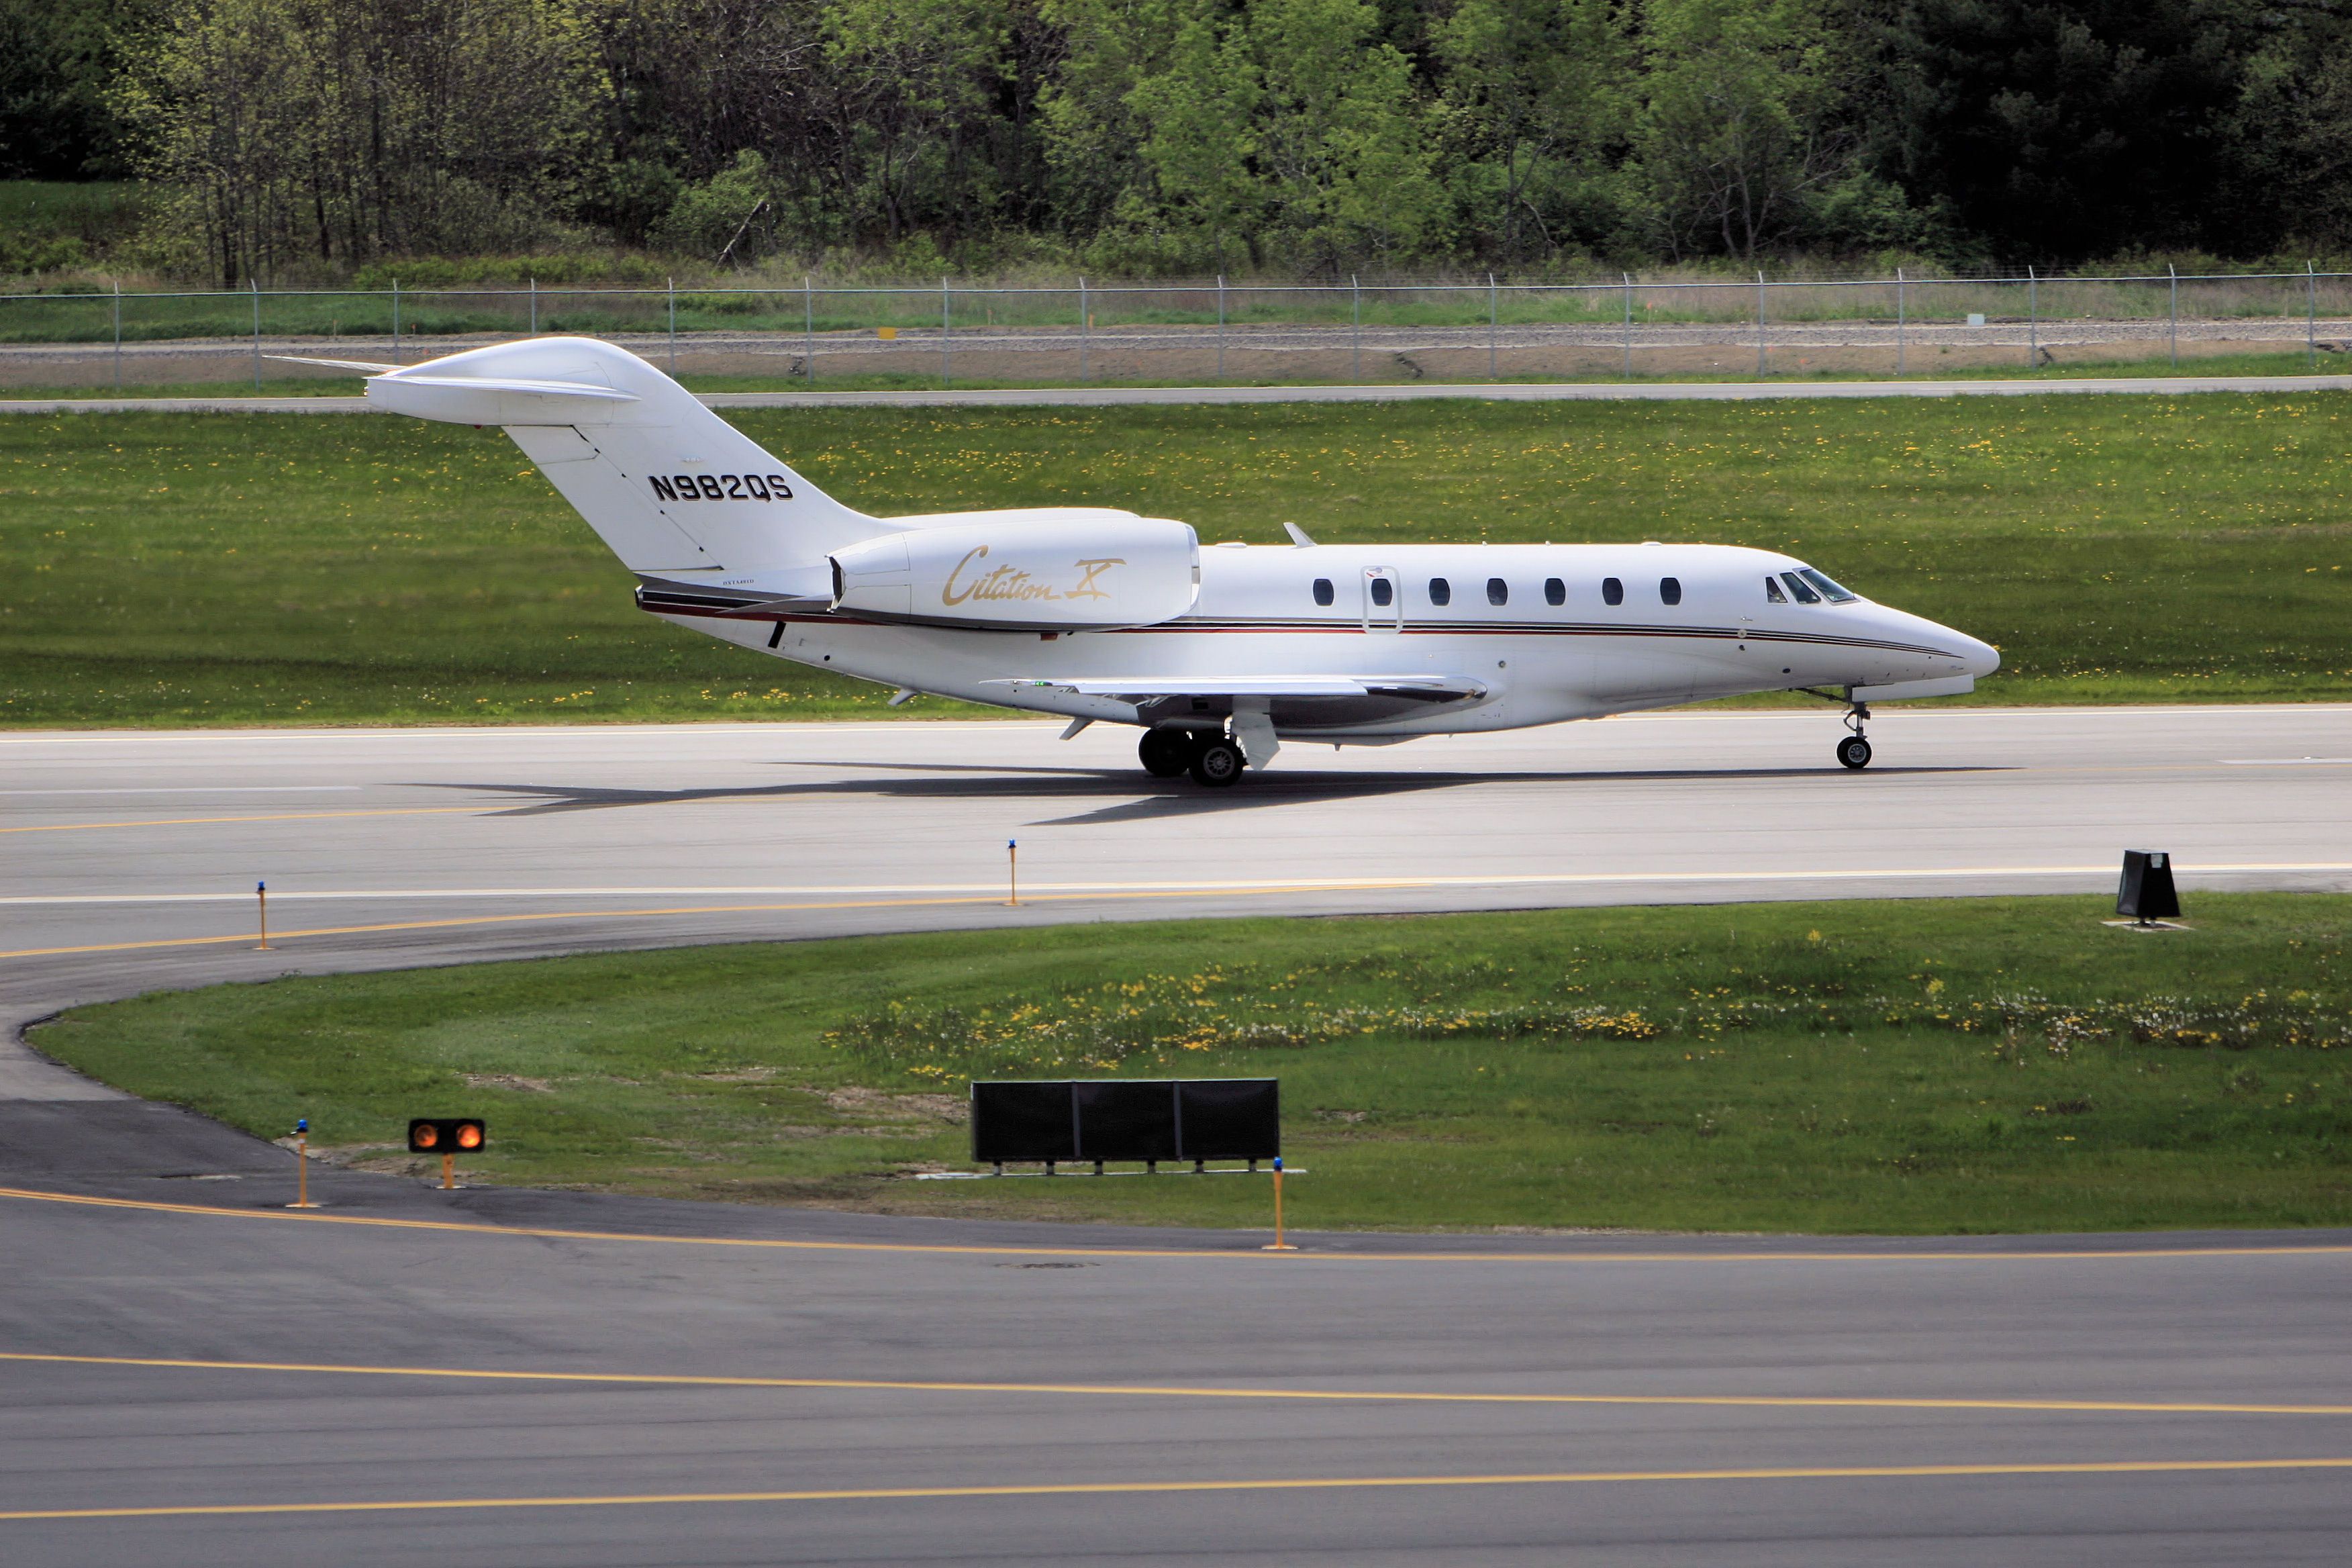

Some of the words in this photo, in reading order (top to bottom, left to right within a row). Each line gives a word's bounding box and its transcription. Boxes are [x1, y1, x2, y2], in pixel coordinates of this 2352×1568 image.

[648, 475, 793, 502] N982QS
[942, 544, 1061, 606] Citation
[1064, 558, 1127, 601] X
